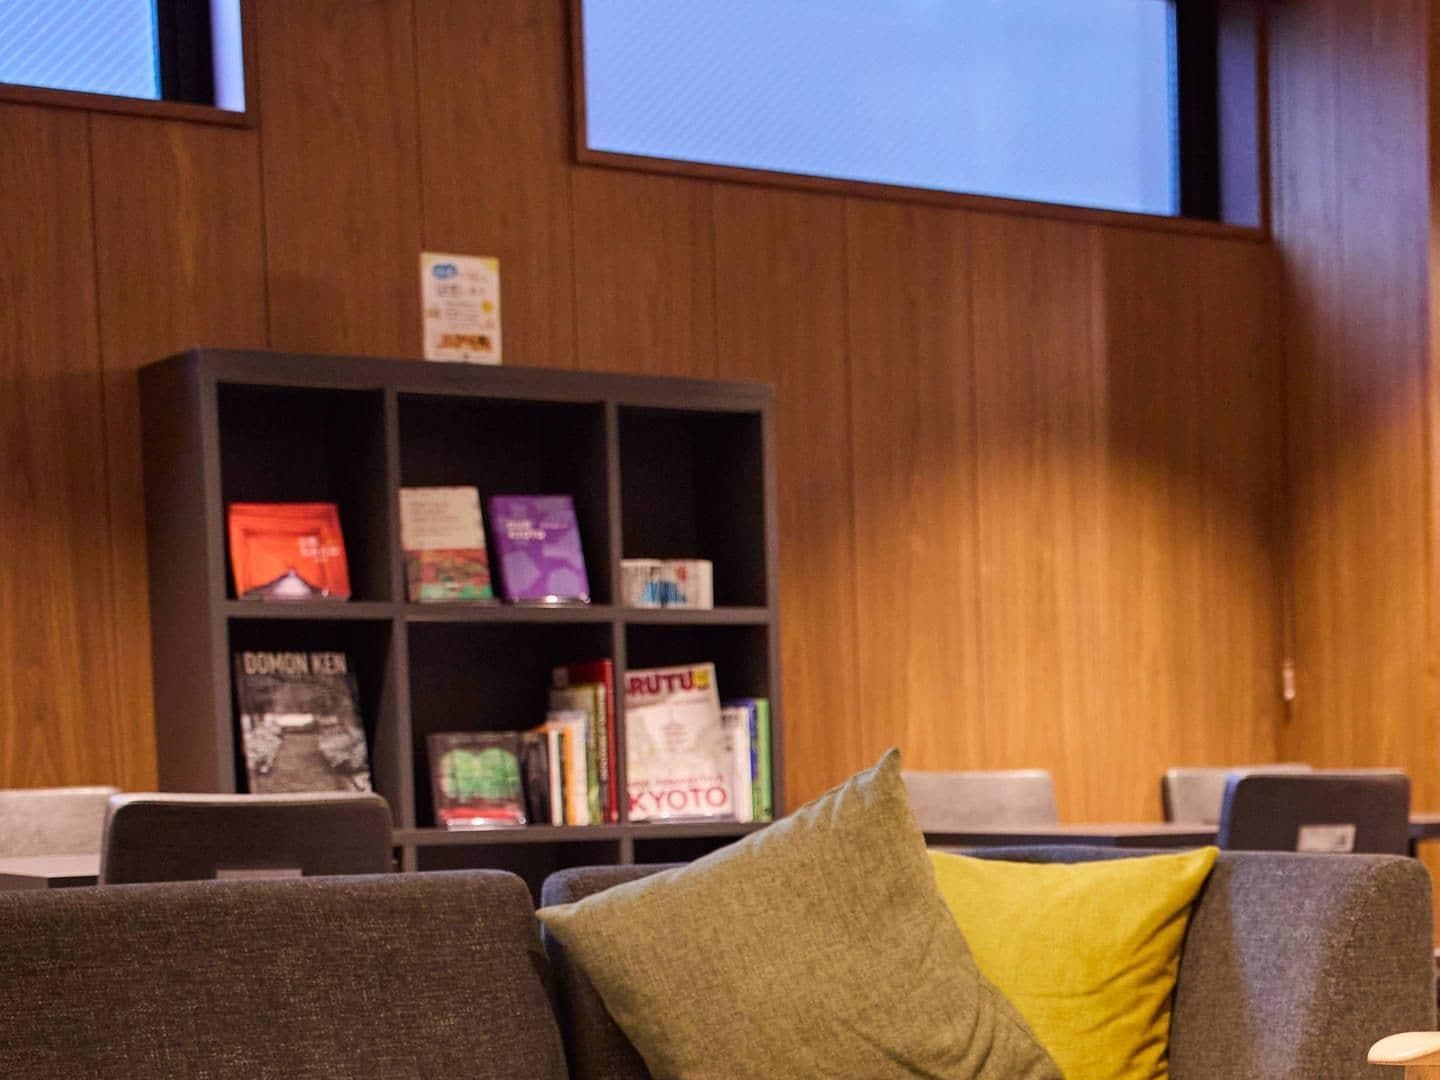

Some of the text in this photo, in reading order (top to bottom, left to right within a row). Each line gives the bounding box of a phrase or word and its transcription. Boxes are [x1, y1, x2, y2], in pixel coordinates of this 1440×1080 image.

[243, 652, 347, 674] DOMON KEN
[628, 671, 709, 696] RUTU
[627, 786, 727, 811] KYOTO
